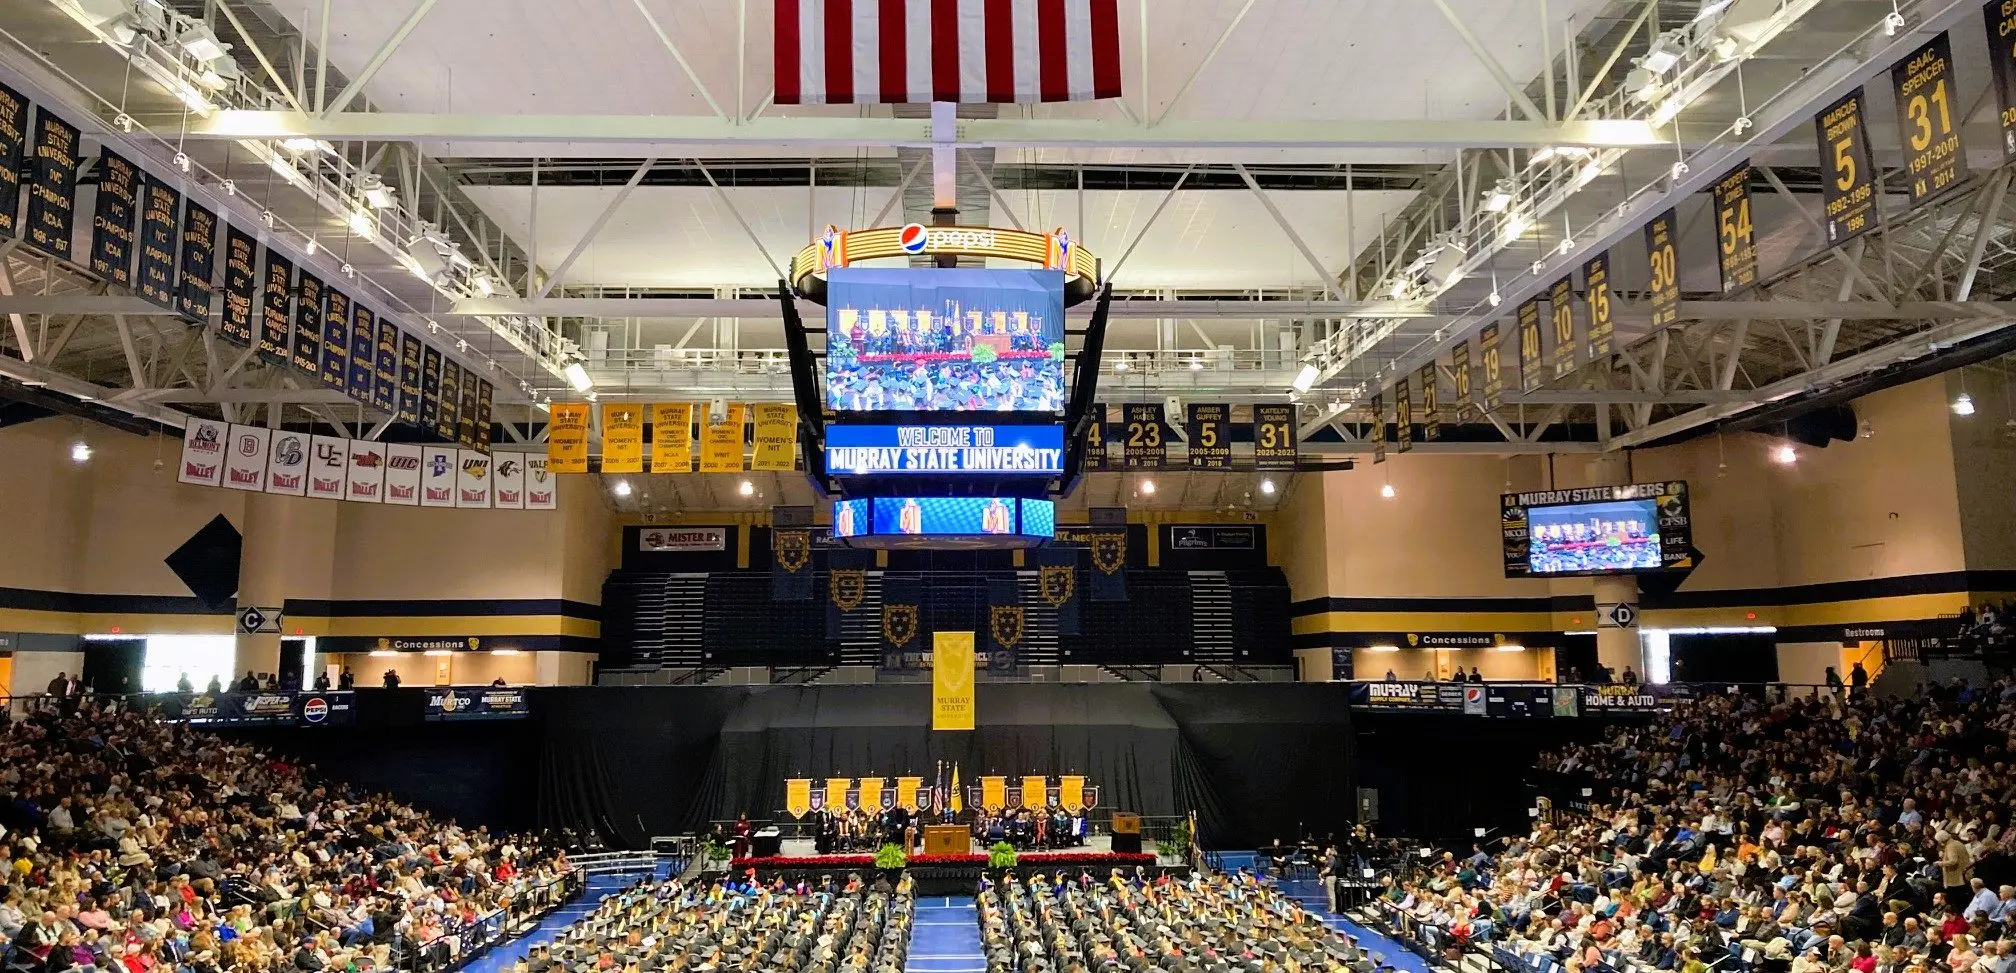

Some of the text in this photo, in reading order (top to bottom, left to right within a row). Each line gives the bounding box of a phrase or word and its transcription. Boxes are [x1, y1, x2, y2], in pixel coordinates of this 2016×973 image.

[1908, 48, 1936, 77] ISAAC
[1902, 58, 1946, 96] SPENCER
[1824, 98, 1858, 128] MARCUS
[1908, 79, 1951, 151] 31
[1826, 114, 1857, 142] BROWN
[47, 133, 70, 153] STATE
[1836, 137, 1856, 191] 5
[1908, 134, 1959, 176] 1997-2001
[1934, 166, 1955, 190] 2014
[1722, 198, 1753, 255] 54
[933, 230, 995, 250] pepsi
[1650, 244, 1676, 292] 30
[1588, 283, 1610, 326] 15
[1554, 304, 1572, 345] 10
[1522, 326, 1539, 361] 40
[1484, 348, 1499, 383] 19
[1456, 364, 1469, 396] 16
[764, 406, 790, 414] MURRAY
[1196, 406, 1221, 414] AMBER
[1424, 384, 1437, 415] 21
[758, 420, 793, 428] UNIVERSITY
[1128, 422, 1160, 447] 23
[1200, 422, 1217, 447] 5
[756, 436, 794, 444] WOMEN'S
[898, 427, 994, 448] WELCOME TO
[1260, 424, 1290, 448] 31
[830, 448, 1061, 471] MURRAY STATE UNIVERSITY
[1126, 448, 1165, 456] 2005-2009
[463, 459, 489, 470] UNI
[1518, 490, 1571, 506] MURRAY
[1572, 486, 1611, 503] STATE
[668, 532, 704, 542] MISTER
[245, 612, 259, 628] C
[1616, 608, 1631, 623] D
[1423, 636, 1491, 645] Concessions
[1845, 628, 1885, 638] Restrooms
[394, 640, 464, 650] Concessions
[937, 696, 971, 705] MURRAY
[1369, 684, 1419, 697] MURRAY
[1586, 695, 1655, 706] HOME & AUTO
[1598, 686, 1639, 696] MURRAY
[941, 704, 966, 712] STATE
